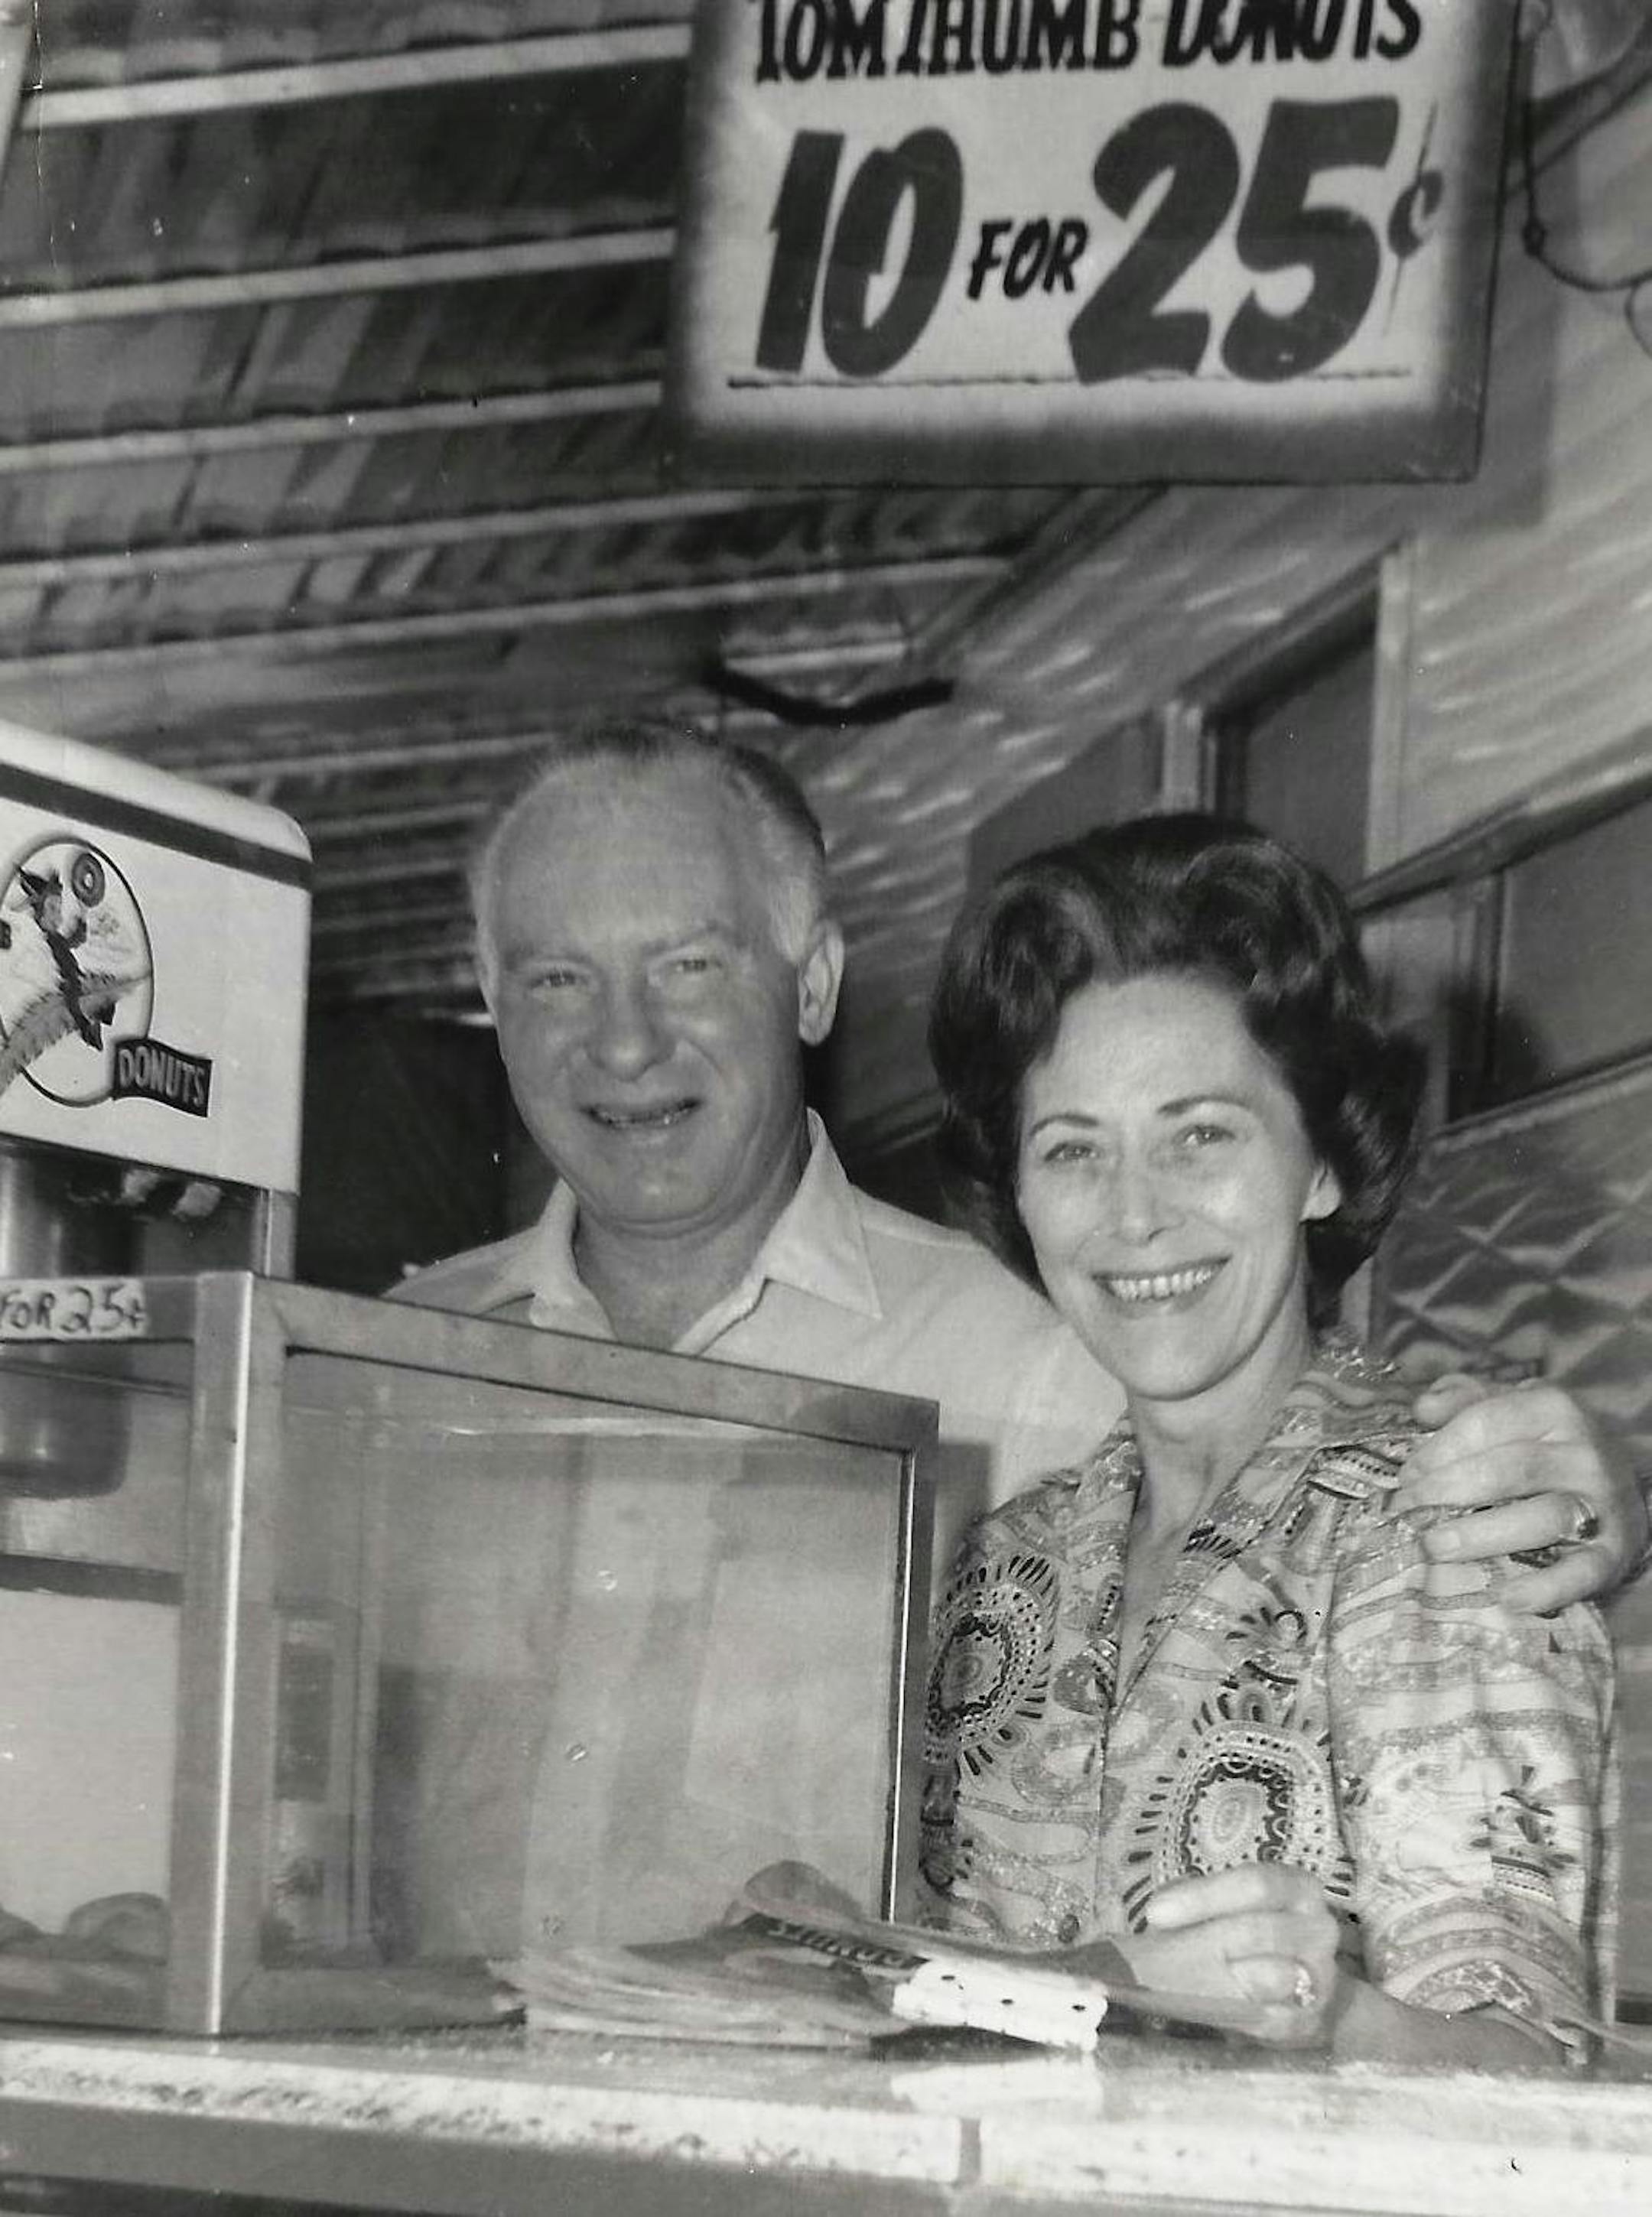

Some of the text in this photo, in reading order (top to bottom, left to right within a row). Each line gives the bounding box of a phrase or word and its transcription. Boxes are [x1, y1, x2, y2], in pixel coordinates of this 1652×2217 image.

[755, 0, 887, 84] TOM
[896, 0, 1139, 76] THUMB
[755, 126, 964, 377] 10
[967, 216, 1091, 301] FOR
[118, 1045, 206, 1108] DONUTS
